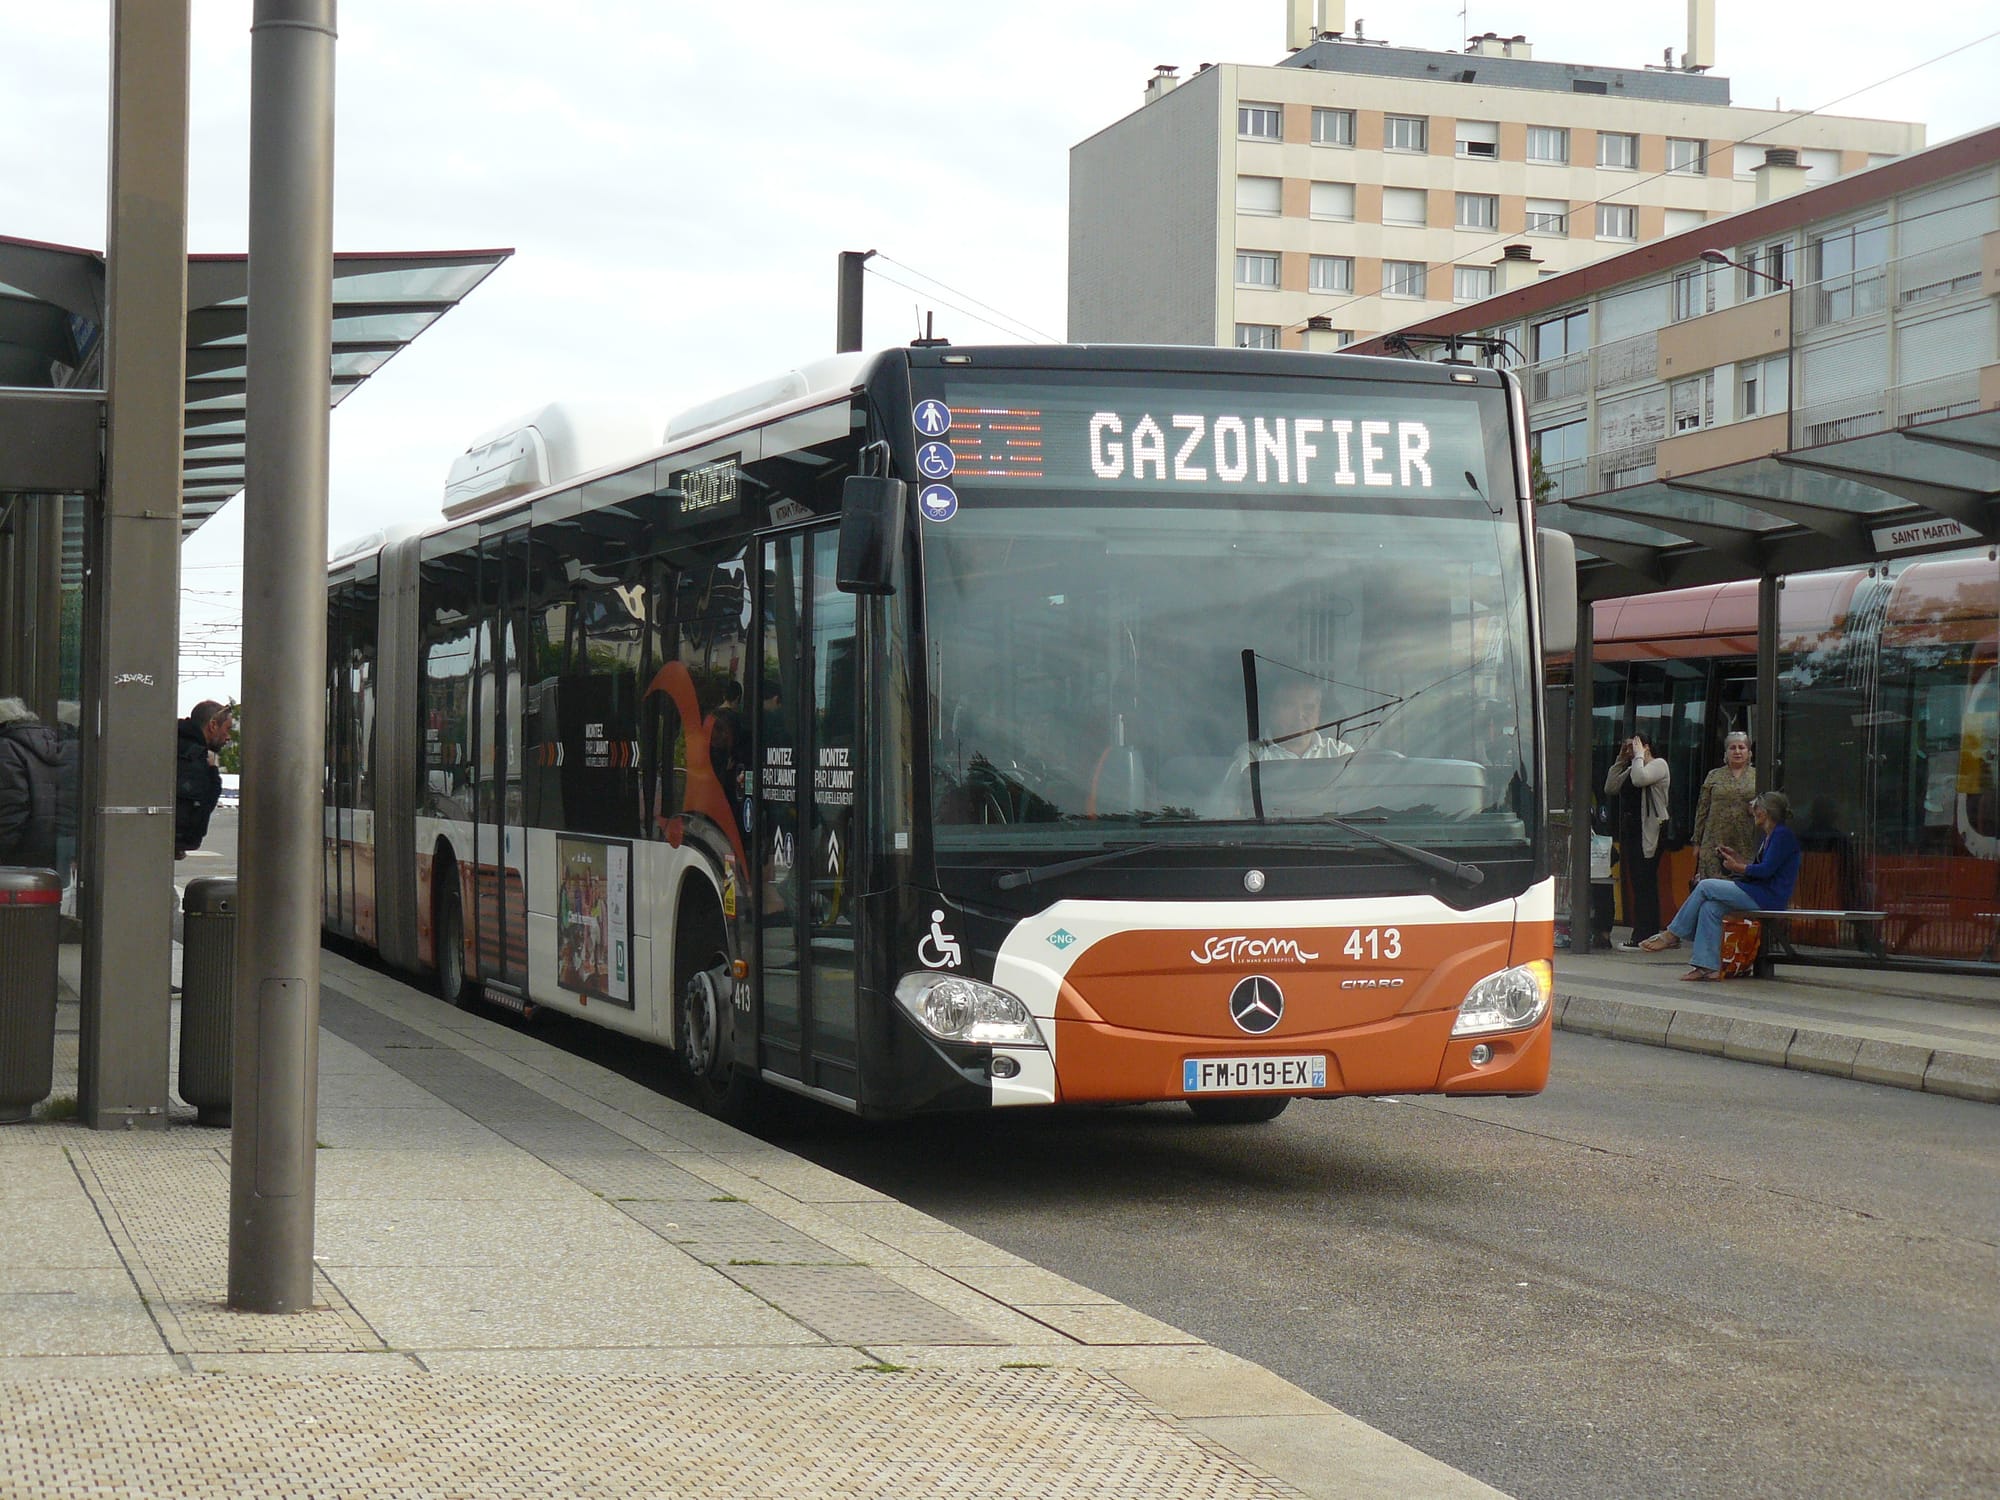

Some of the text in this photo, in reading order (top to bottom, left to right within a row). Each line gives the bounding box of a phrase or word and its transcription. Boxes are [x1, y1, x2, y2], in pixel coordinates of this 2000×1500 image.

[1089, 411, 1433, 488] GAZONFIER
[1891, 522, 1962, 545] SAINT MARTIN
[767, 747, 792, 766] MONTEZ
[819, 748, 849, 767] MONTEZ
[762, 768, 774, 785] PAR
[814, 769, 854, 789] PAR L'AVANT
[1049, 934, 1073, 944] CNG
[1343, 928, 1402, 960] 413
[1340, 978, 1404, 989] CITARO
[734, 982, 751, 1012] 413
[1202, 1060, 1308, 1087] FM-019-EX
[1312, 1072, 1324, 1085] 72
